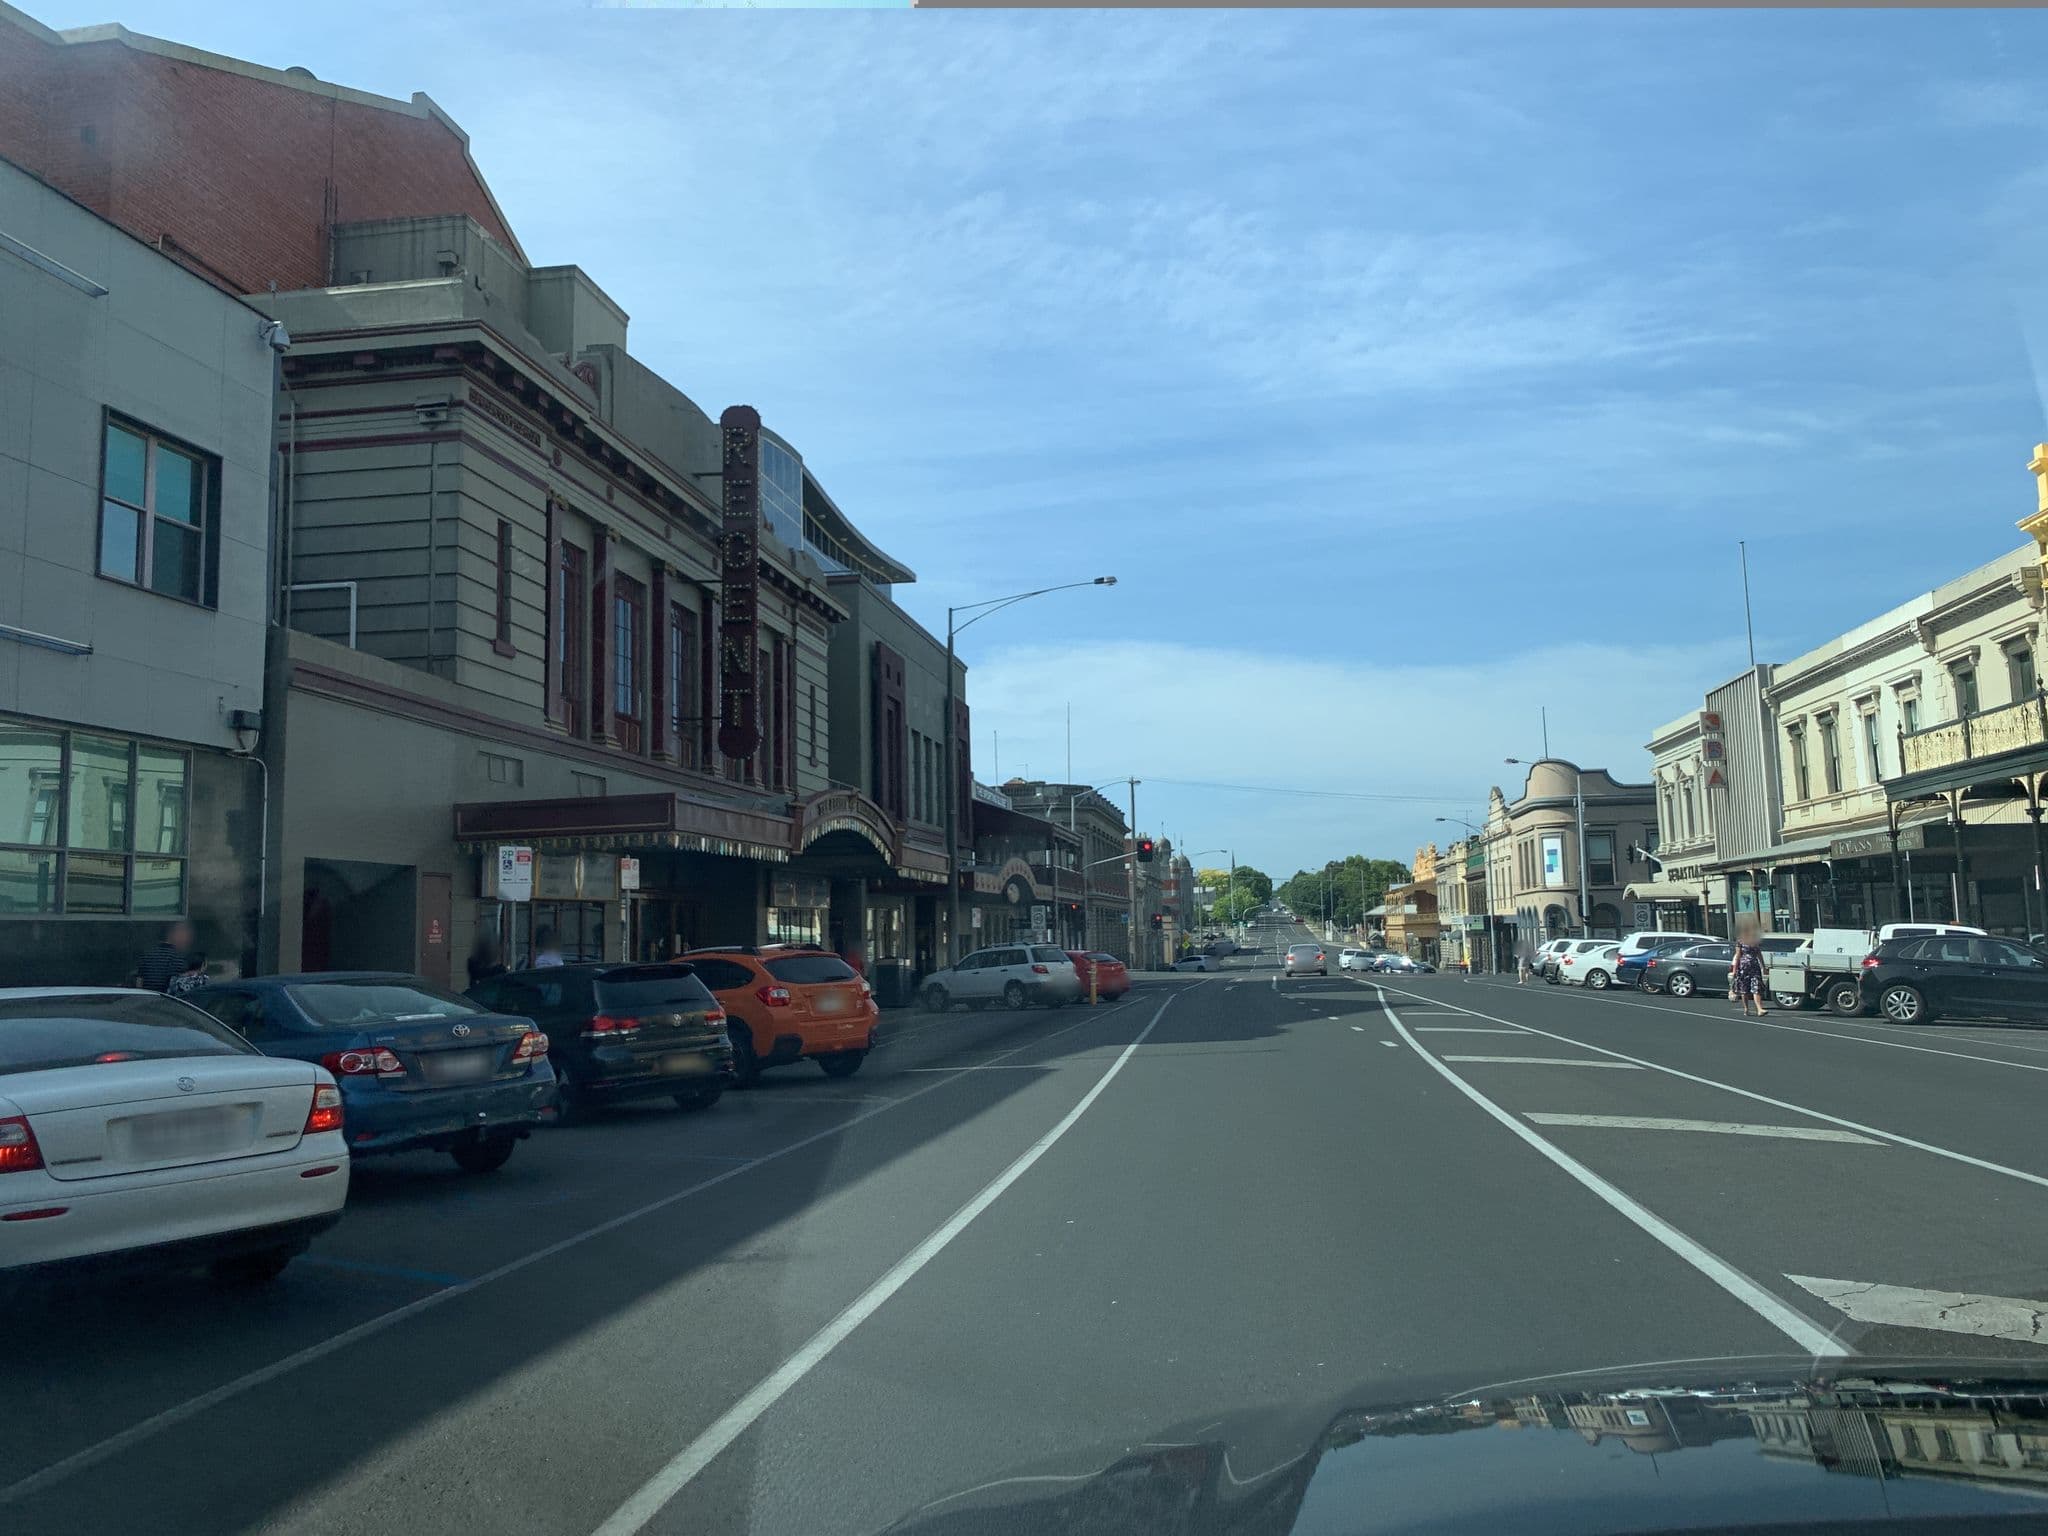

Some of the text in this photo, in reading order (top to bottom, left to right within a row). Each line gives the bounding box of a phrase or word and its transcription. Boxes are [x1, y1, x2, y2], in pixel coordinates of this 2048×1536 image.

[724, 427, 753, 728] REGENT
[502, 850, 513, 859] 2P
[1838, 839, 1873, 855] EVANS
[1668, 864, 1703, 881] SEBASTIA
